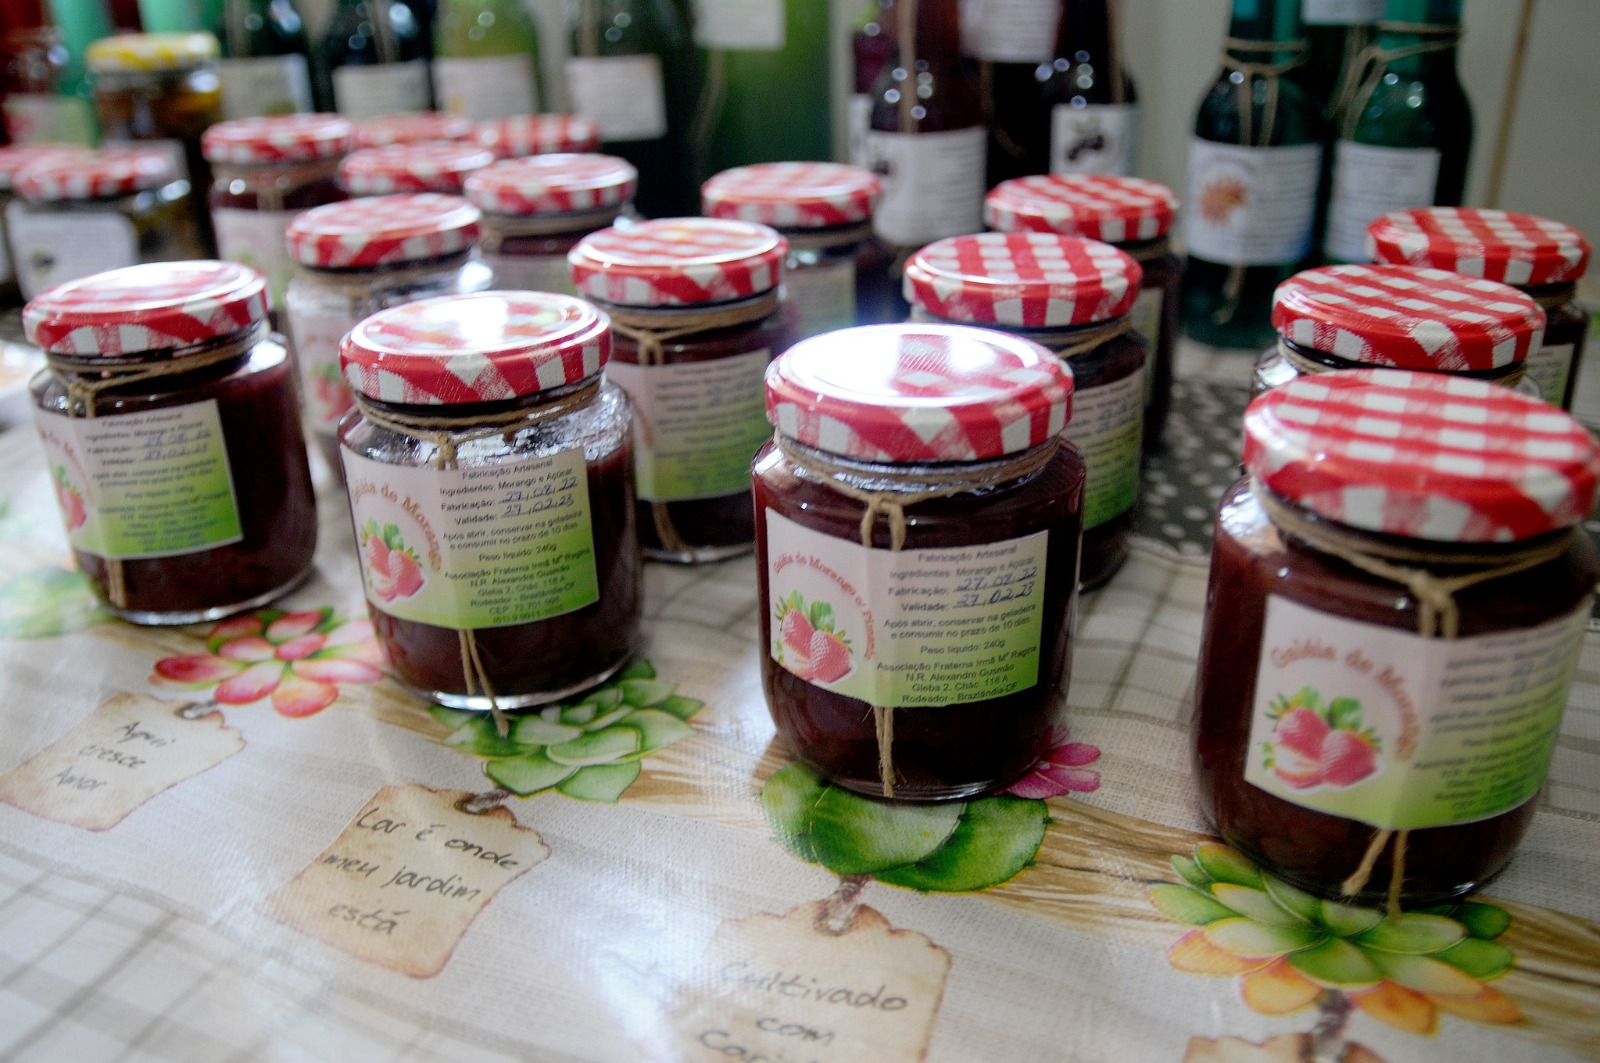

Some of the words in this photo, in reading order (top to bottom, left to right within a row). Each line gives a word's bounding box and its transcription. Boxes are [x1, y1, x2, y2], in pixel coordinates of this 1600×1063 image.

[462, 467, 511, 481] Fabricação
[513, 460, 553, 475] Artesanal
[498, 478, 537, 491] Morango
[440, 498, 495, 512] Fabricação:
[454, 513, 497, 526] Validade:
[442, 530, 464, 542] Após
[490, 522, 533, 537] conservar
[534, 520, 546, 529] na
[456, 539, 497, 550] consumir
[512, 533, 537, 546] prazo
[538, 527, 549, 537] de
[551, 524, 562, 534] 10
[478, 552, 501, 562] Peso
[918, 551, 973, 564] Fabricação
[975, 545, 1018, 560] Artesanal
[809, 554, 856, 596] Morango
[955, 564, 996, 577] Morango
[887, 586, 948, 598] Fabricação:
[884, 618, 909, 630] Após
[911, 618, 936, 628] abrir,
[938, 615, 986, 627] conservar
[987, 613, 999, 622] na
[1000, 603, 1036, 620] geladeira
[901, 602, 948, 612] Validade:
[899, 630, 944, 640] consumir
[946, 629, 959, 638] no
[960, 627, 987, 640] prazo
[988, 623, 1000, 633] de
[1003, 621, 1013, 630] 10
[1013, 616, 1030, 627] dias
[920, 645, 945, 655] Peso
[983, 639, 1006, 649] 240g
[876, 662, 931, 674] Associação
[933, 660, 974, 671] Fraterna
[930, 671, 977, 682] Alexandre
[979, 662, 1015, 677] Gusmão
[1346, 649, 1374, 674] de
[912, 682, 941, 692] Gleba
[985, 677, 1000, 687] 118
[902, 693, 949, 703] Rodeador
[78, 744, 147, 769] cresce
[53, 765, 108, 793] Amor
[356, 806, 406, 834] Lar
[415, 823, 446, 842] é
[444, 838, 519, 870] onde
[323, 853, 380, 878] meu
[380, 864, 481, 903] jardim
[327, 902, 411, 935] está
[718, 960, 909, 1012] Cultivado
[755, 1016, 835, 1048] com
